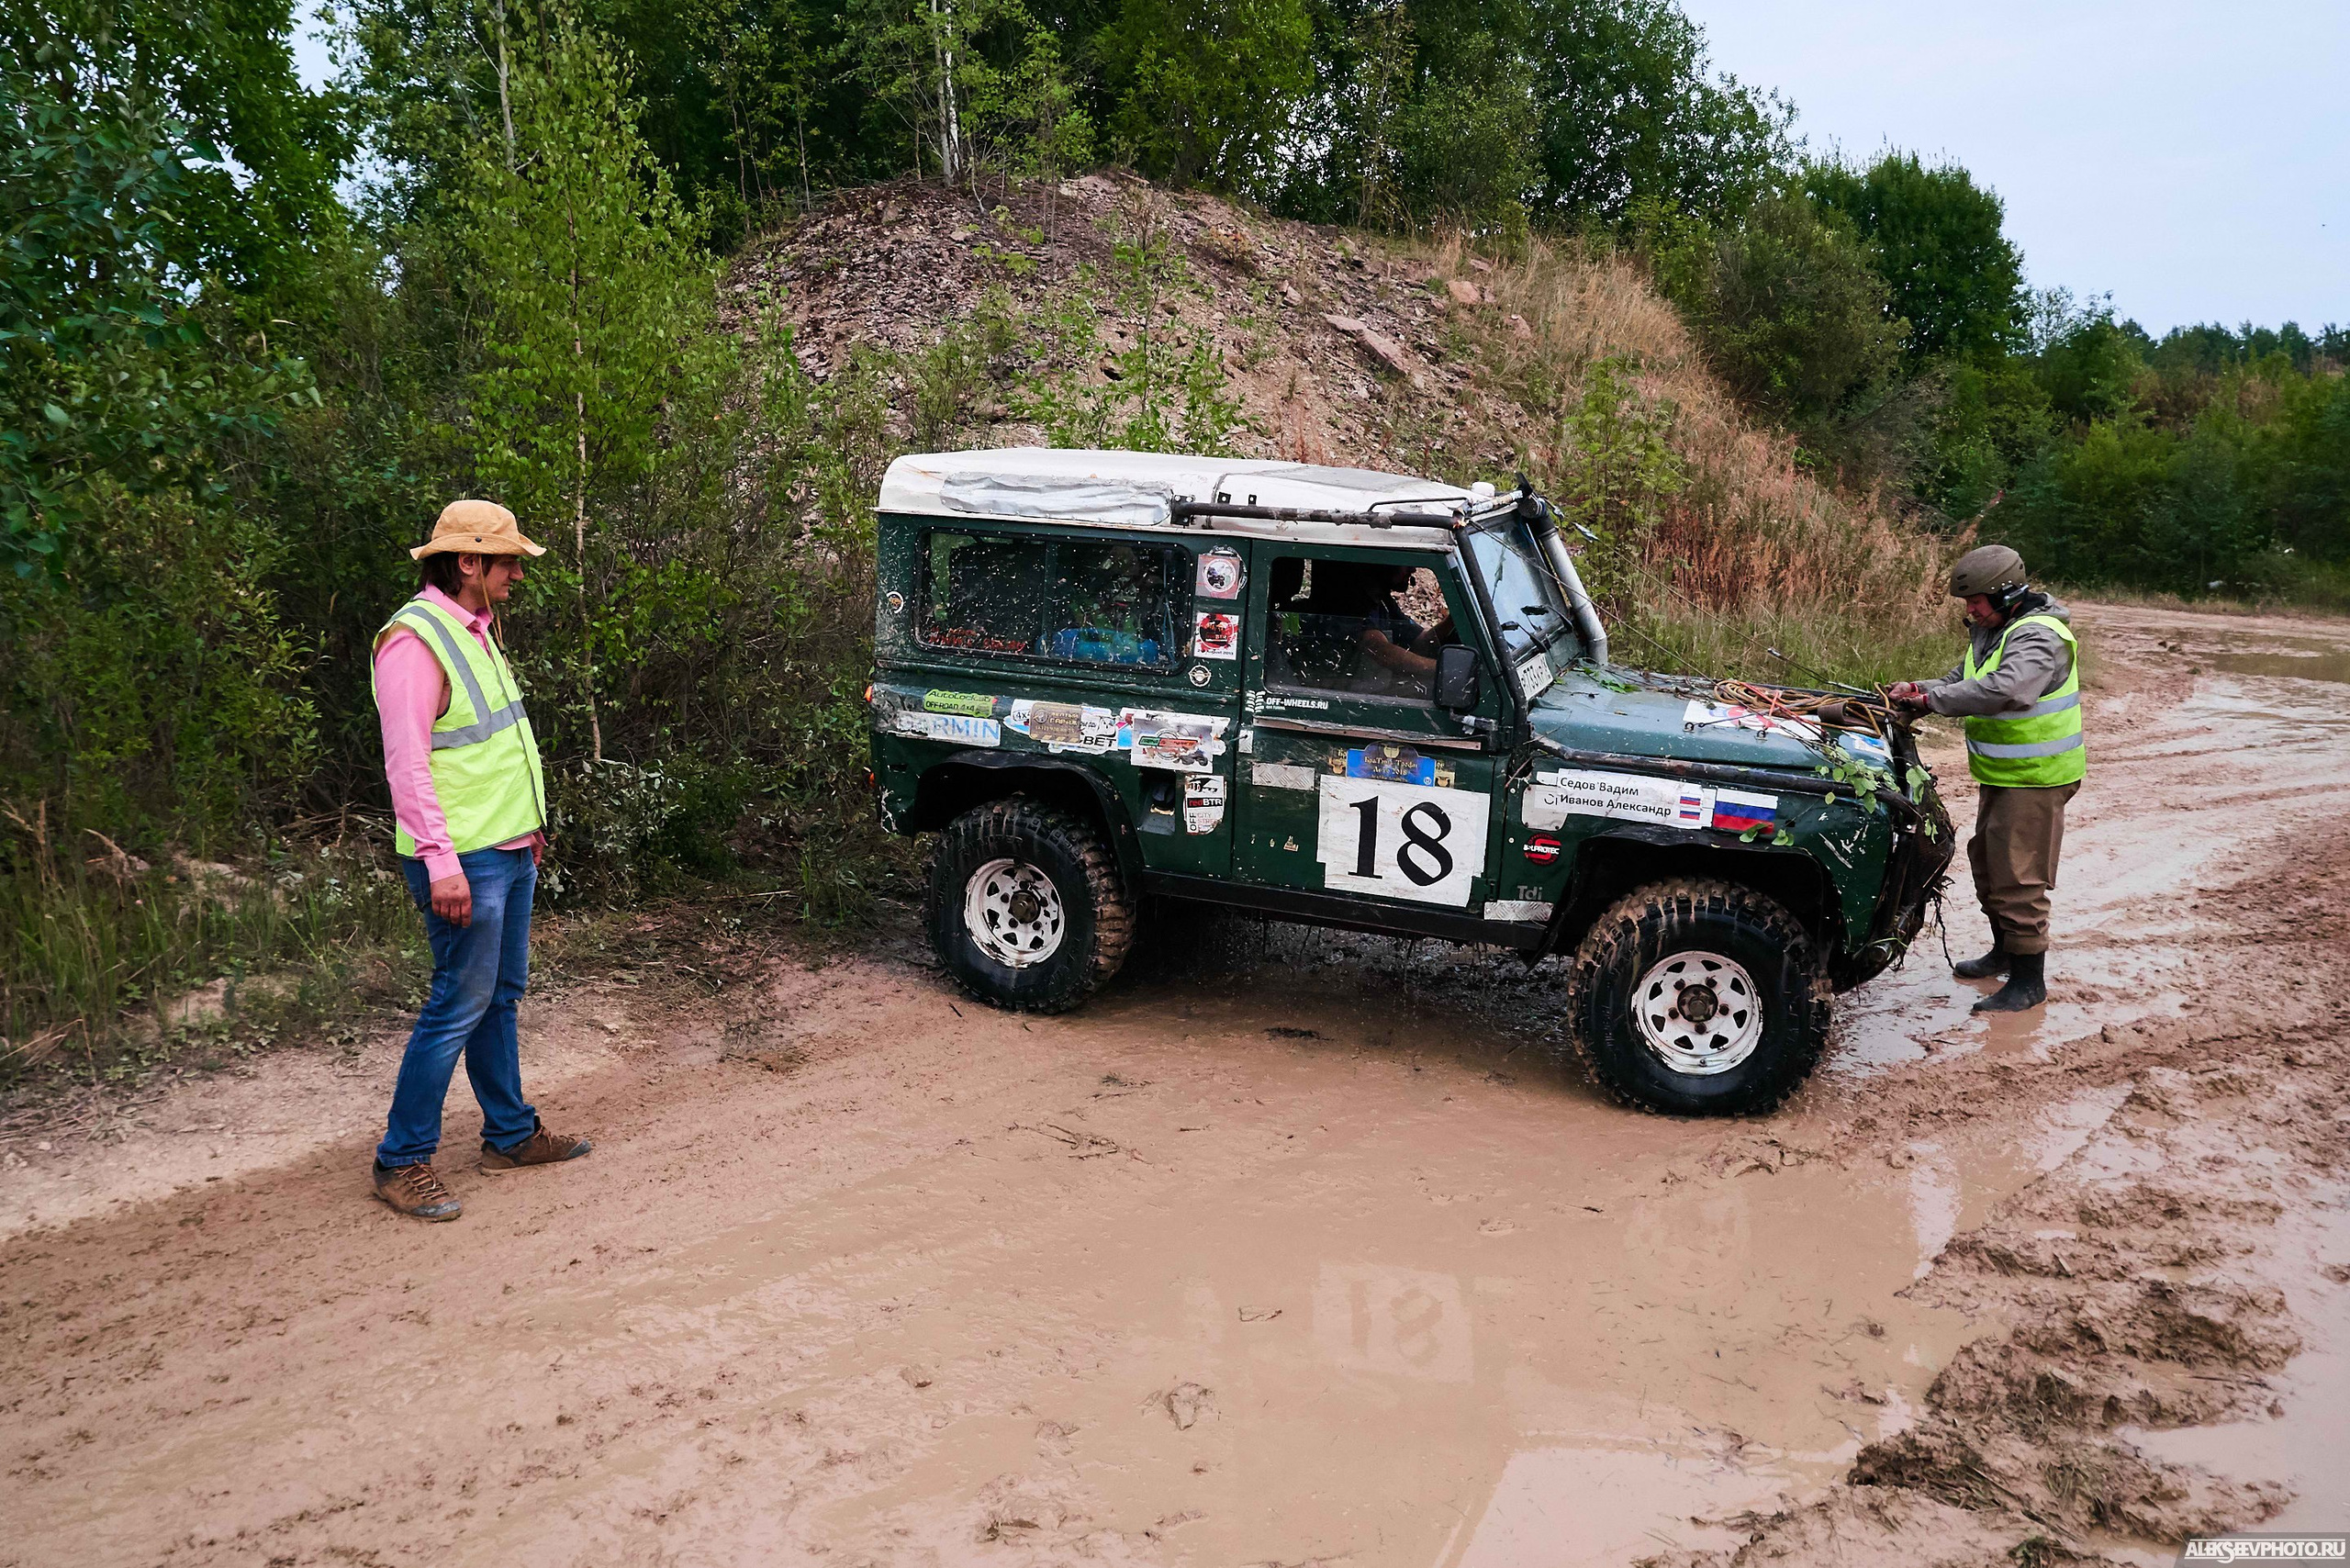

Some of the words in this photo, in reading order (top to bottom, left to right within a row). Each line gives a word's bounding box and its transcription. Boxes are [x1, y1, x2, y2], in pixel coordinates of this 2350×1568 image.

[1266, 697, 1328, 710] OFF-WHEELS.RU
[1560, 777, 1595, 791] Седов
[1599, 781, 1639, 796] Вадим
[1189, 798, 1223, 807] redBTR
[1560, 794, 1604, 808] Иванов
[1606, 799, 1672, 816] Александр
[1348, 795, 1453, 887] 18
[1516, 885, 1543, 901] Tdi
